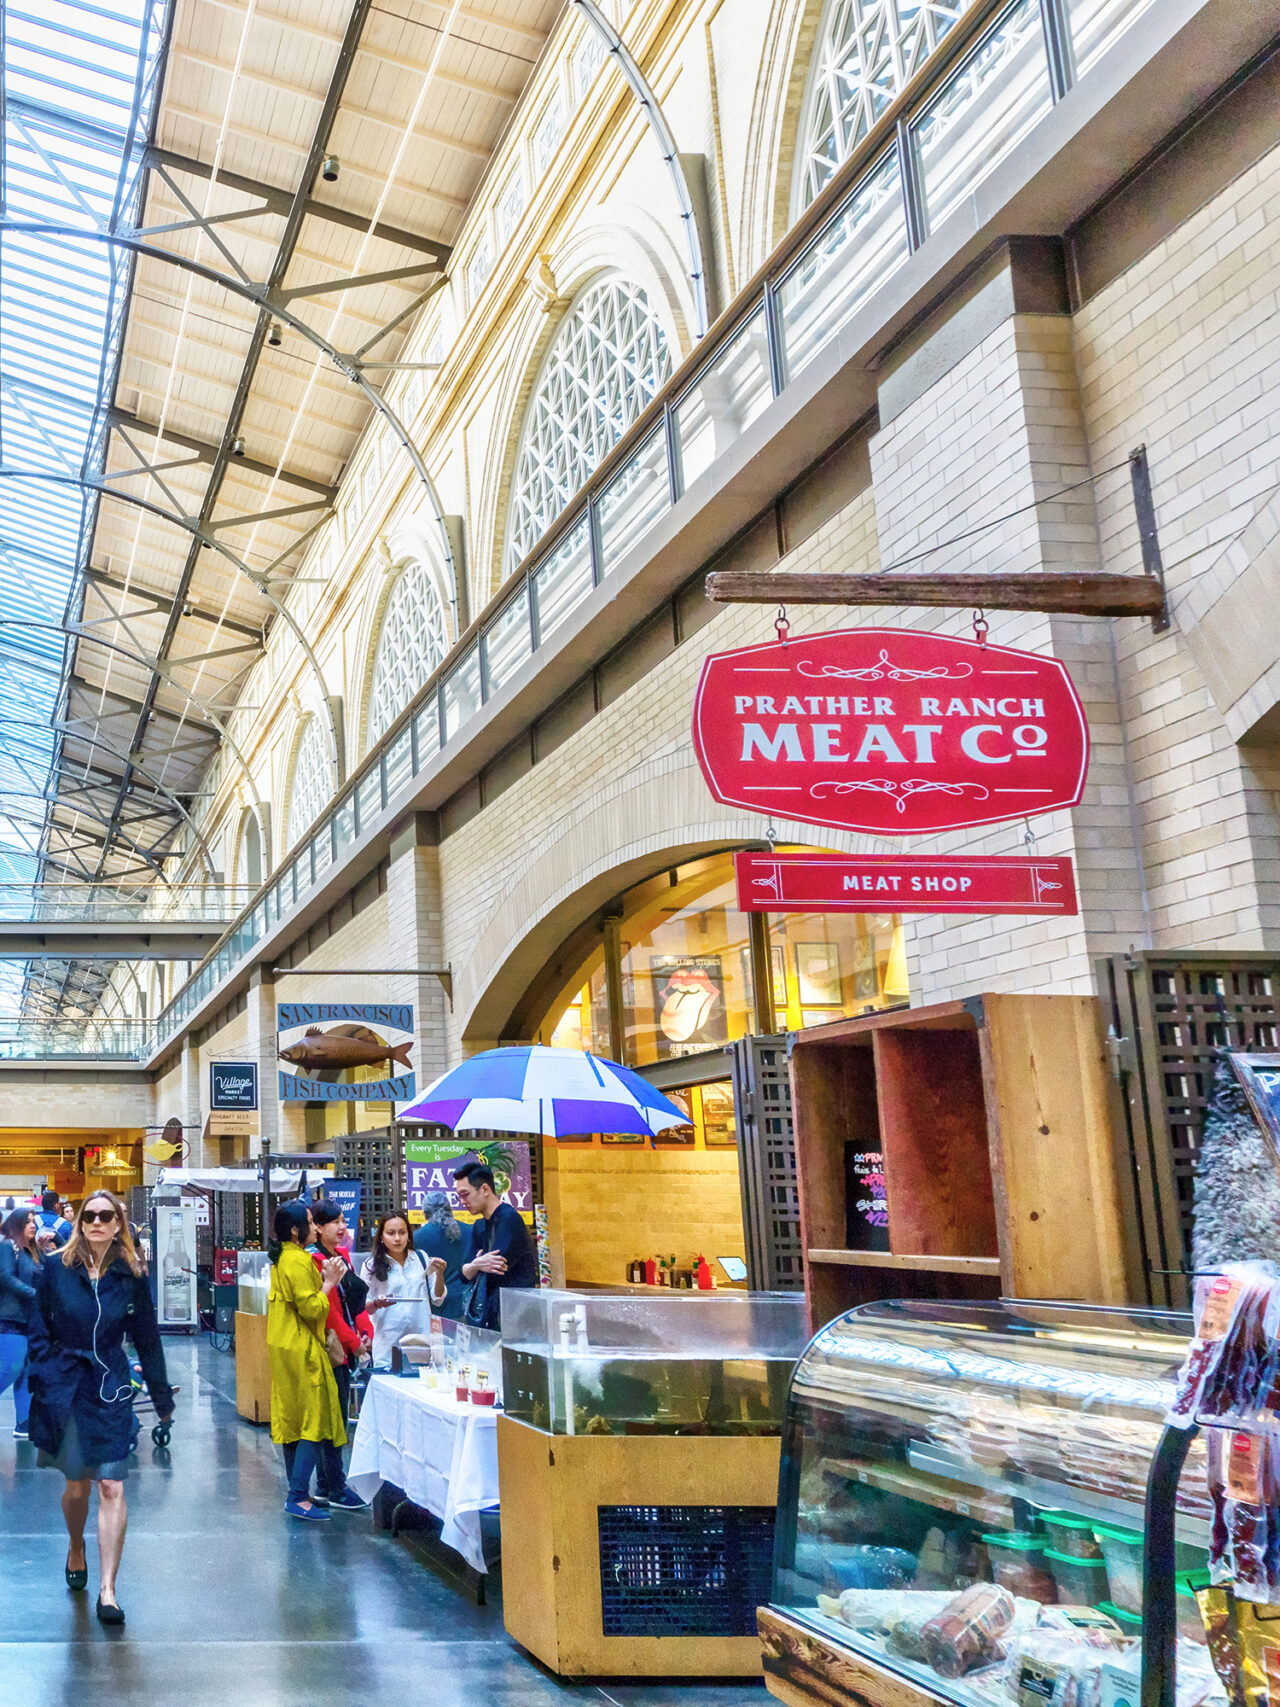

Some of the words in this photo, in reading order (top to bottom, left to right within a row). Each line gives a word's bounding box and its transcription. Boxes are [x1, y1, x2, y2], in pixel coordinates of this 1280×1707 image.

[734, 695, 896, 715] PRATHER
[920, 697, 1046, 717] RANCH
[739, 722, 943, 764] MEAT
[843, 875, 902, 891] MEAT
[911, 876, 972, 892] SHOP
[280, 1005, 313, 1028] SAN
[318, 1005, 412, 1030] FRANCISCO
[215, 1076, 253, 1091] Village
[282, 1074, 322, 1099] FISH
[326, 1074, 412, 1100] COMPANY
[411, 1143, 432, 1153] Every
[433, 1143, 464, 1153] Tuesday
[410, 1190, 529, 1209] TEAY
